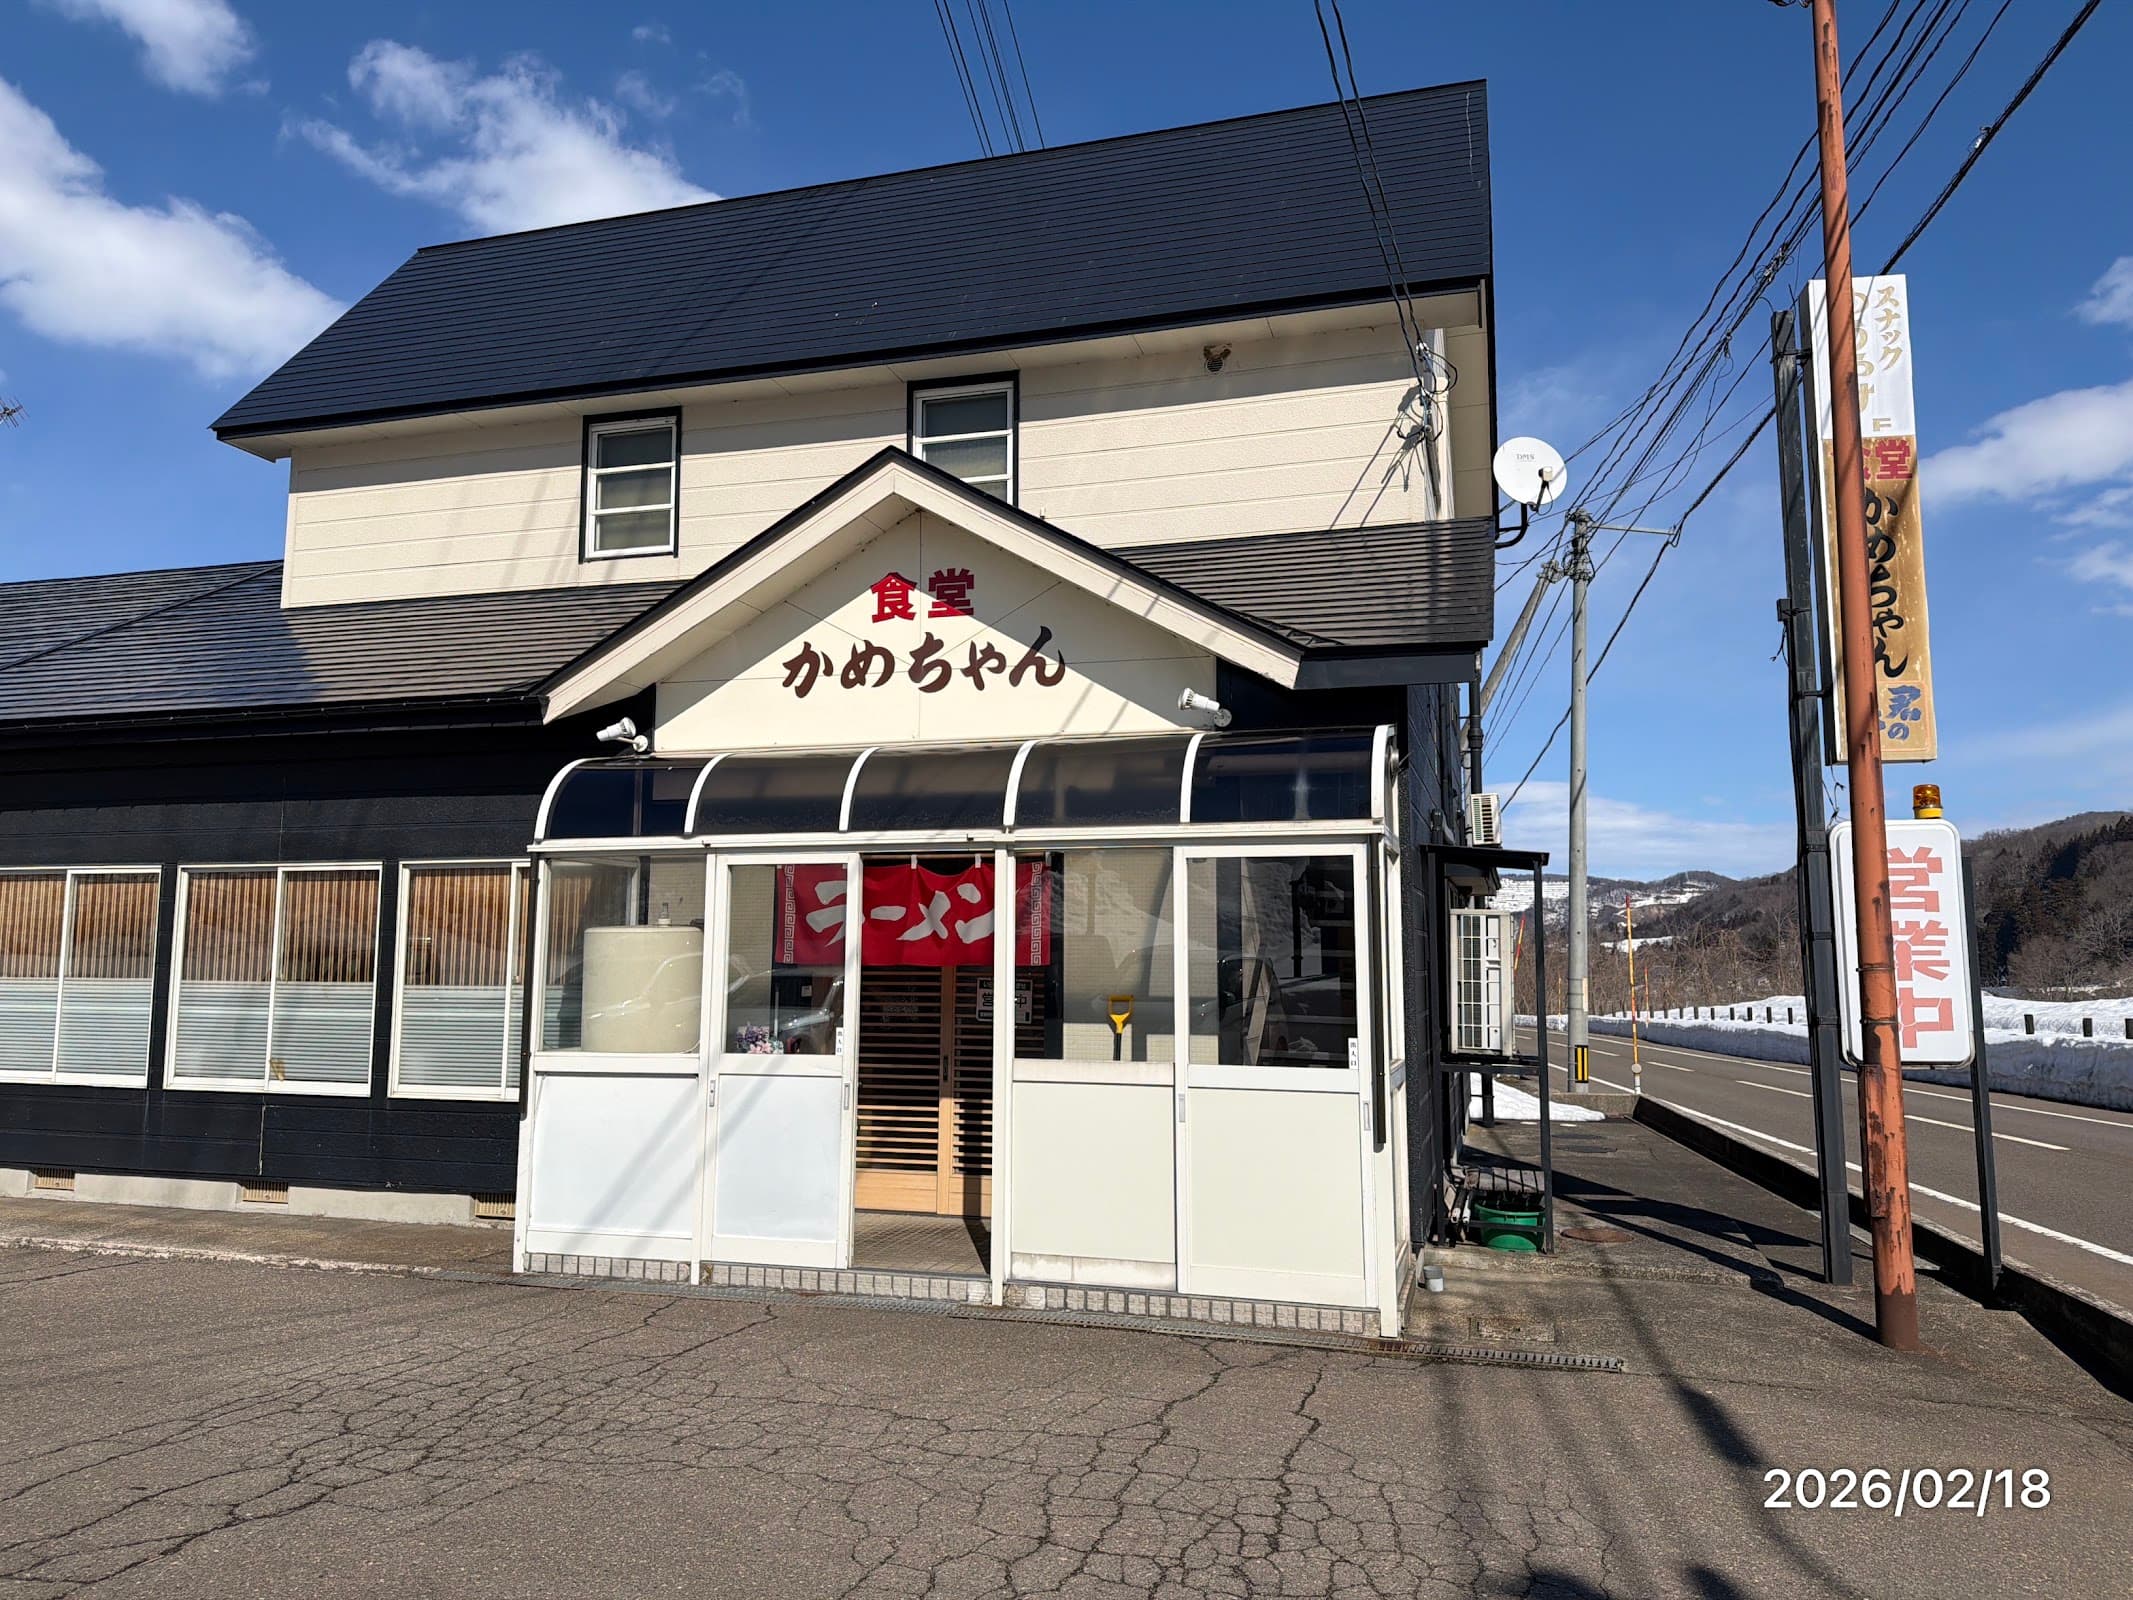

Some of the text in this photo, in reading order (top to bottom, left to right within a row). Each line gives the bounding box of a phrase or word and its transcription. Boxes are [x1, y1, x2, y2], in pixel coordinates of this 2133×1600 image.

[1874, 286, 1903, 371] スナック
[870, 567, 975, 623] 食堂
[806, 882, 994, 946] ラーメン
